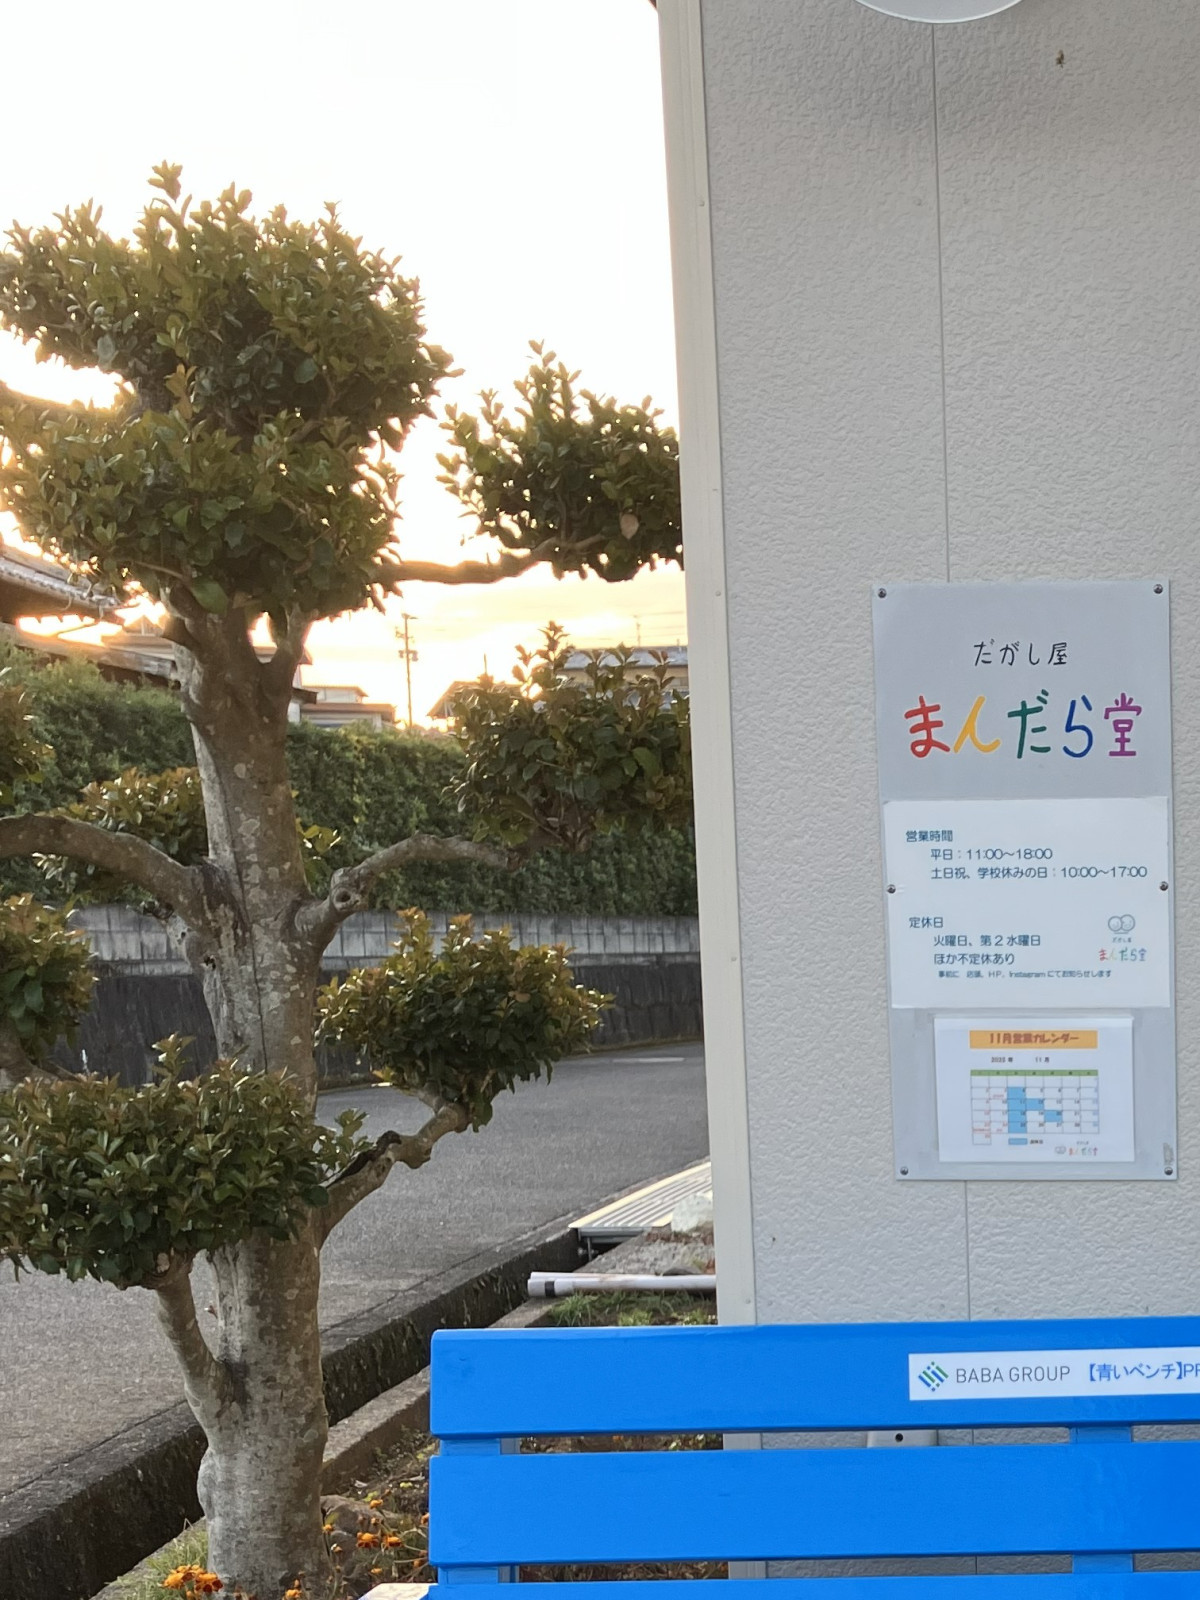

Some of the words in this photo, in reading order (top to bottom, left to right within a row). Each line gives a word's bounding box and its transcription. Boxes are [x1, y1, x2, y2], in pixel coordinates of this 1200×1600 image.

[973, 638, 1068, 667] だがし屋
[903, 688, 1143, 759] まんだら堂
[905, 829, 954, 843] 営業時間
[908, 916, 944, 929] 定休日
[933, 953, 1015, 966] ほか不定休あり
[989, 1032, 1080, 1045] 11月営業カレンダー
[955, 1367, 1004, 1384] BABA
[1008, 1365, 1071, 1382] GROUP
